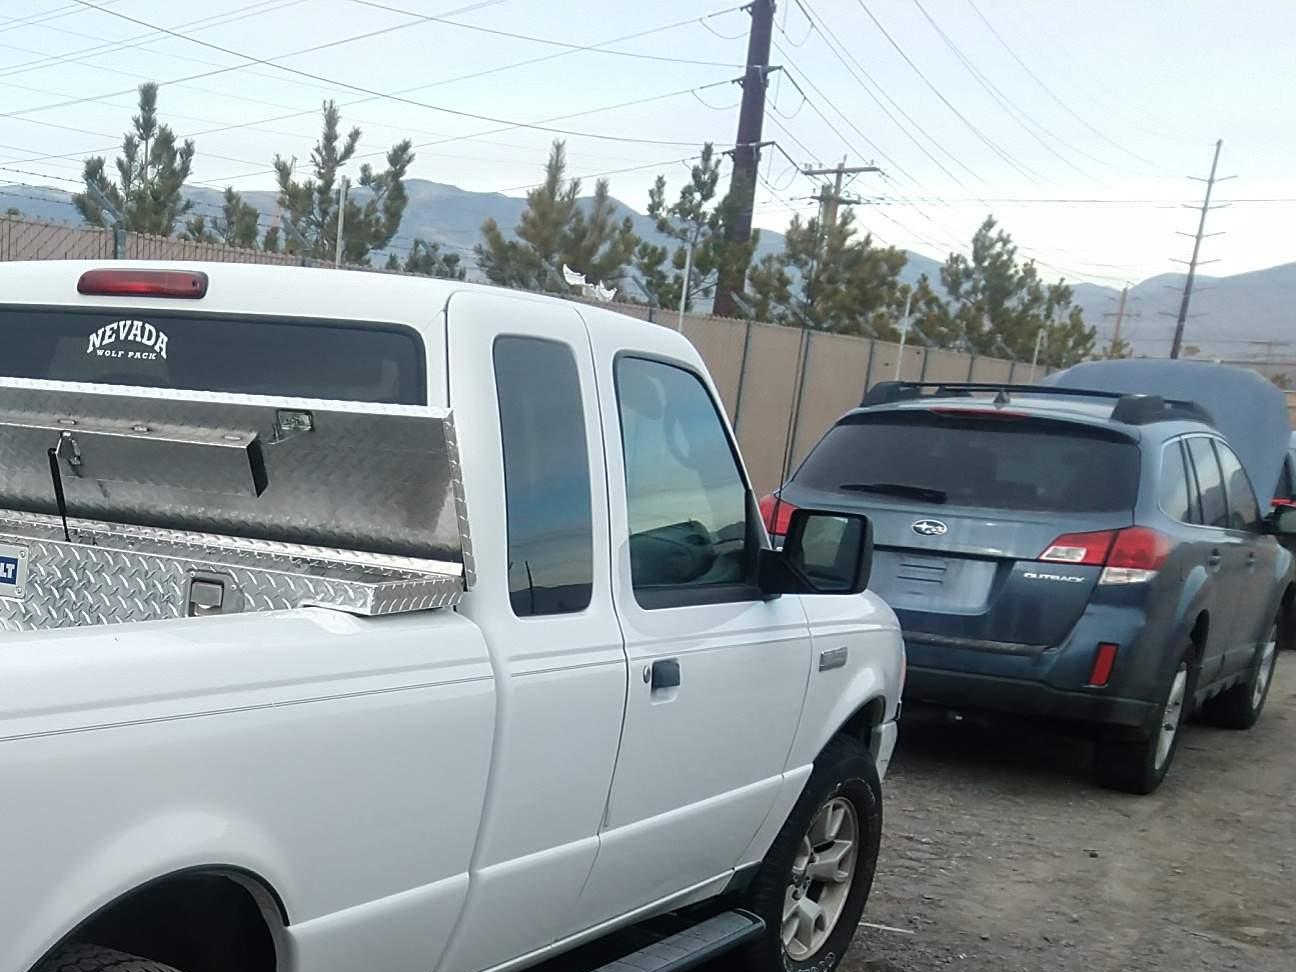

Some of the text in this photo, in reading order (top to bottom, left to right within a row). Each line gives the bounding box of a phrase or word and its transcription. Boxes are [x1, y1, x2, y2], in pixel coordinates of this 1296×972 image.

[87, 320, 168, 359] NEVADA
[96, 350, 157, 360] WOLF PACK
[1023, 572, 1085, 583] OUTBACK
